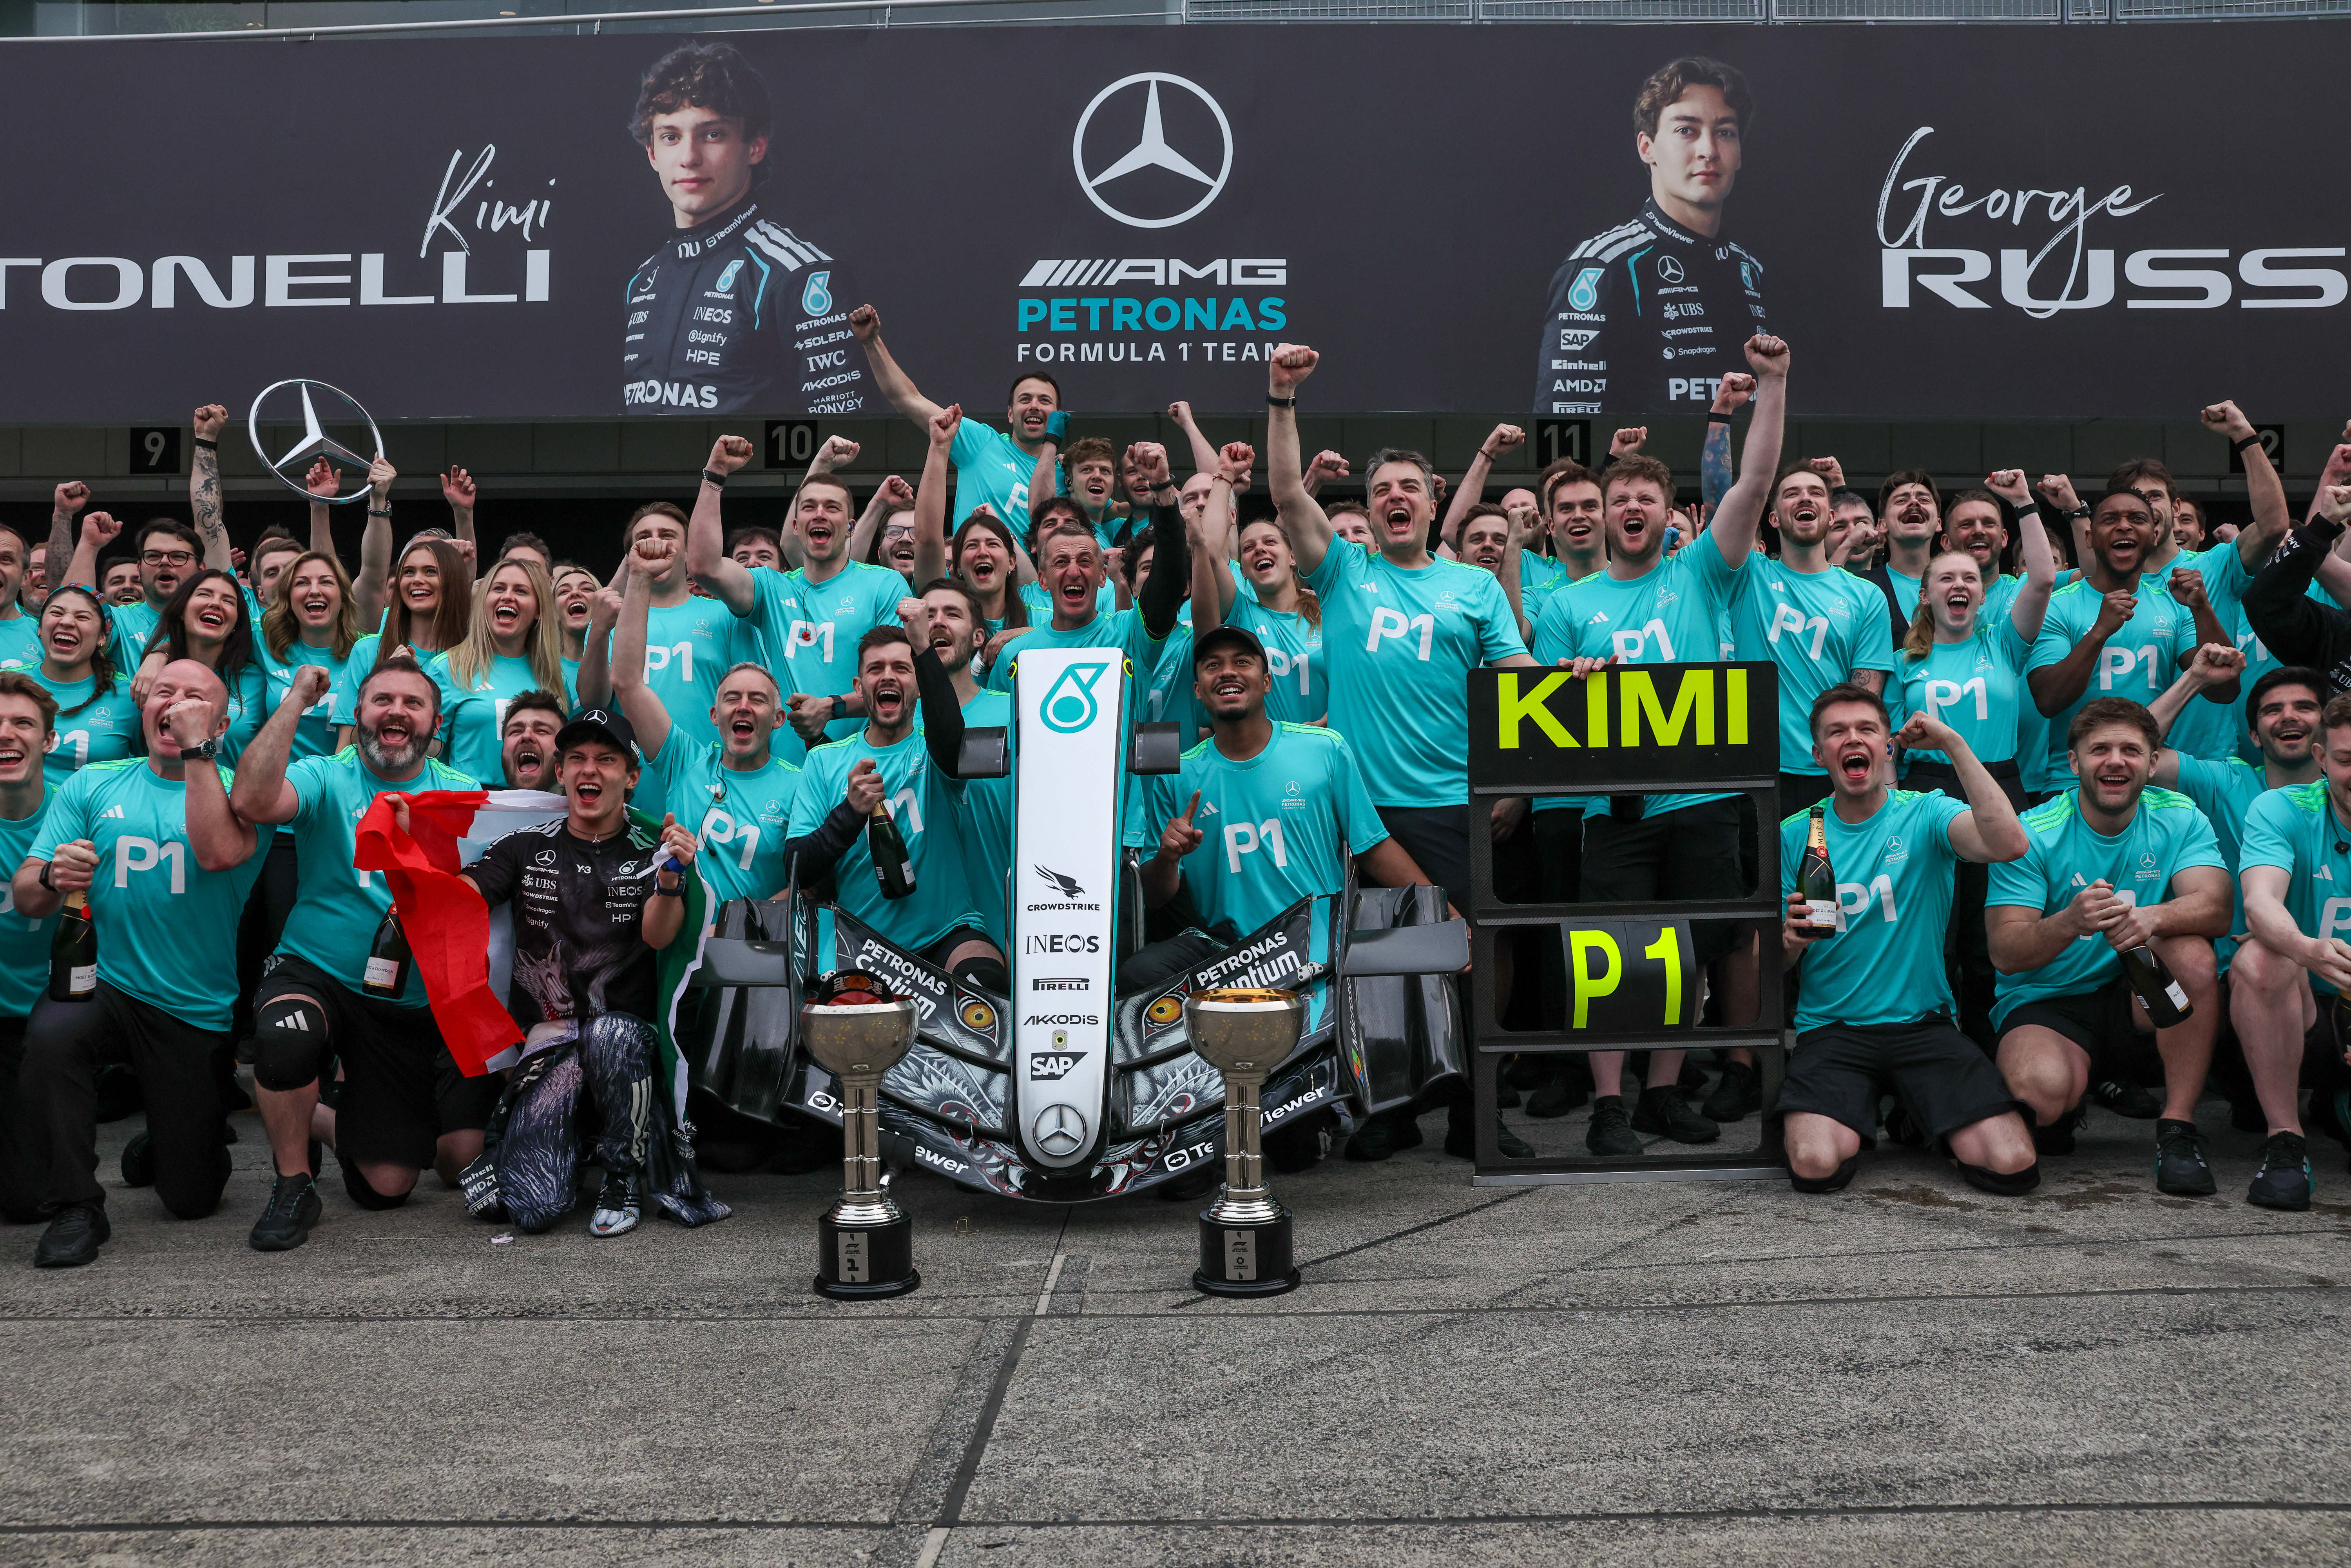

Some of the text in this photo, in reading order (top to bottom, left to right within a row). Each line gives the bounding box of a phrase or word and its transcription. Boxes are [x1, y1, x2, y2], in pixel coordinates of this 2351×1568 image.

[420, 143, 556, 258] Kimi
[1654, 217, 1695, 244] TeamViewer
[1876, 126, 2165, 318] George
[1103, 259, 1287, 286] AMG
[1882, 248, 2348, 308] RUSS
[703, 291, 734, 300] PETRONAS
[632, 311, 649, 324] UBS
[692, 306, 732, 324] INEOS
[1018, 297, 1286, 331] PETRONAS
[1558, 312, 1606, 322] PETRONAS
[1680, 303, 1704, 316] UBS
[795, 313, 847, 332] PETRONAS
[1666, 326, 1713, 336] CROWDSTRIKE
[804, 329, 854, 349] SOLERA
[1561, 333, 1590, 346] SAP
[686, 349, 720, 366] HPE
[807, 349, 846, 372] IWC
[1018, 343, 1166, 362] FORMULA
[1678, 346, 1716, 356] Snapdragon
[1552, 359, 1607, 370] Einhell
[1553, 379, 1593, 392] AMD
[808, 397, 864, 414] BONVOY
[813, 391, 855, 404] MARRIOTT
[144, 431, 165, 466] 9
[772, 425, 812, 460] 10
[1544, 424, 1580, 460] 11
[2260, 429, 2279, 465] 2
[784, 619, 835, 663] P1
[1366, 606, 1434, 661] P1
[1612, 617, 1676, 664] P1
[1768, 603, 1829, 661] P1
[643, 641, 693, 684] P1
[2100, 645, 2158, 690] P1
[1498, 668, 1748, 749] KIMI
[1924, 677, 1988, 720] P1
[696, 807, 760, 871] P1
[1224, 818, 1288, 873] P1
[115, 835, 185, 894] P1
[1885, 853, 1909, 863] PETRONAS
[535, 878, 557, 890] UBS
[607, 886, 643, 896] INEOS
[522, 890, 558, 902] ROWDSTRIKE
[1836, 874, 1898, 932] P1
[525, 904, 555, 914] Snapdragon
[1027, 903, 1100, 912] CROWDSTRIKE
[527, 917, 549, 929] ignify
[1025, 934, 1099, 954] INEOS
[862, 939, 948, 996] PETRONAS
[1196, 931, 1288, 987] PETRONAS
[1033, 978, 1089, 990] PIRELLI
[1031, 1057, 1074, 1076] SAP
[460, 1164, 494, 1187] inhell
